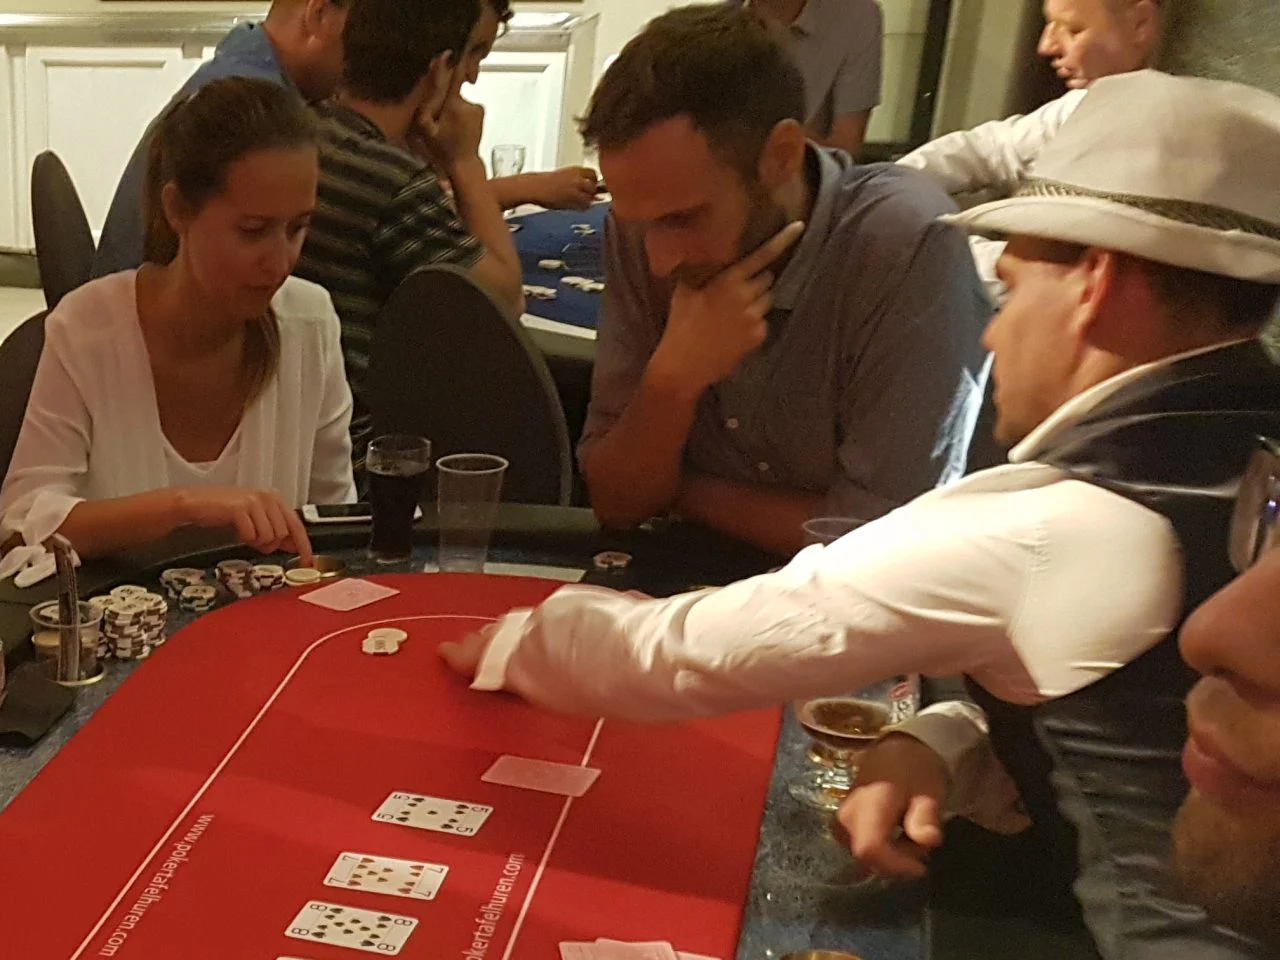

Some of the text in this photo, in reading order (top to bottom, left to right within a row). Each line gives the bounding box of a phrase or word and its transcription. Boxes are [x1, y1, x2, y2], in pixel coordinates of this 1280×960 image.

[392, 793, 410, 801] 5
[471, 805, 489, 813] 5
[376, 812, 395, 821] 5
[455, 824, 474, 833] 5
[342, 854, 359, 862] 7
[328, 876, 347, 885] 7
[98, 814, 215, 957] www.pokertafelhuren.com
[414, 890, 432, 898] 7
[310, 903, 328, 912] 8
[394, 918, 413, 926] 8
[291, 927, 310, 936] 8
[376, 942, 396, 951] 8
